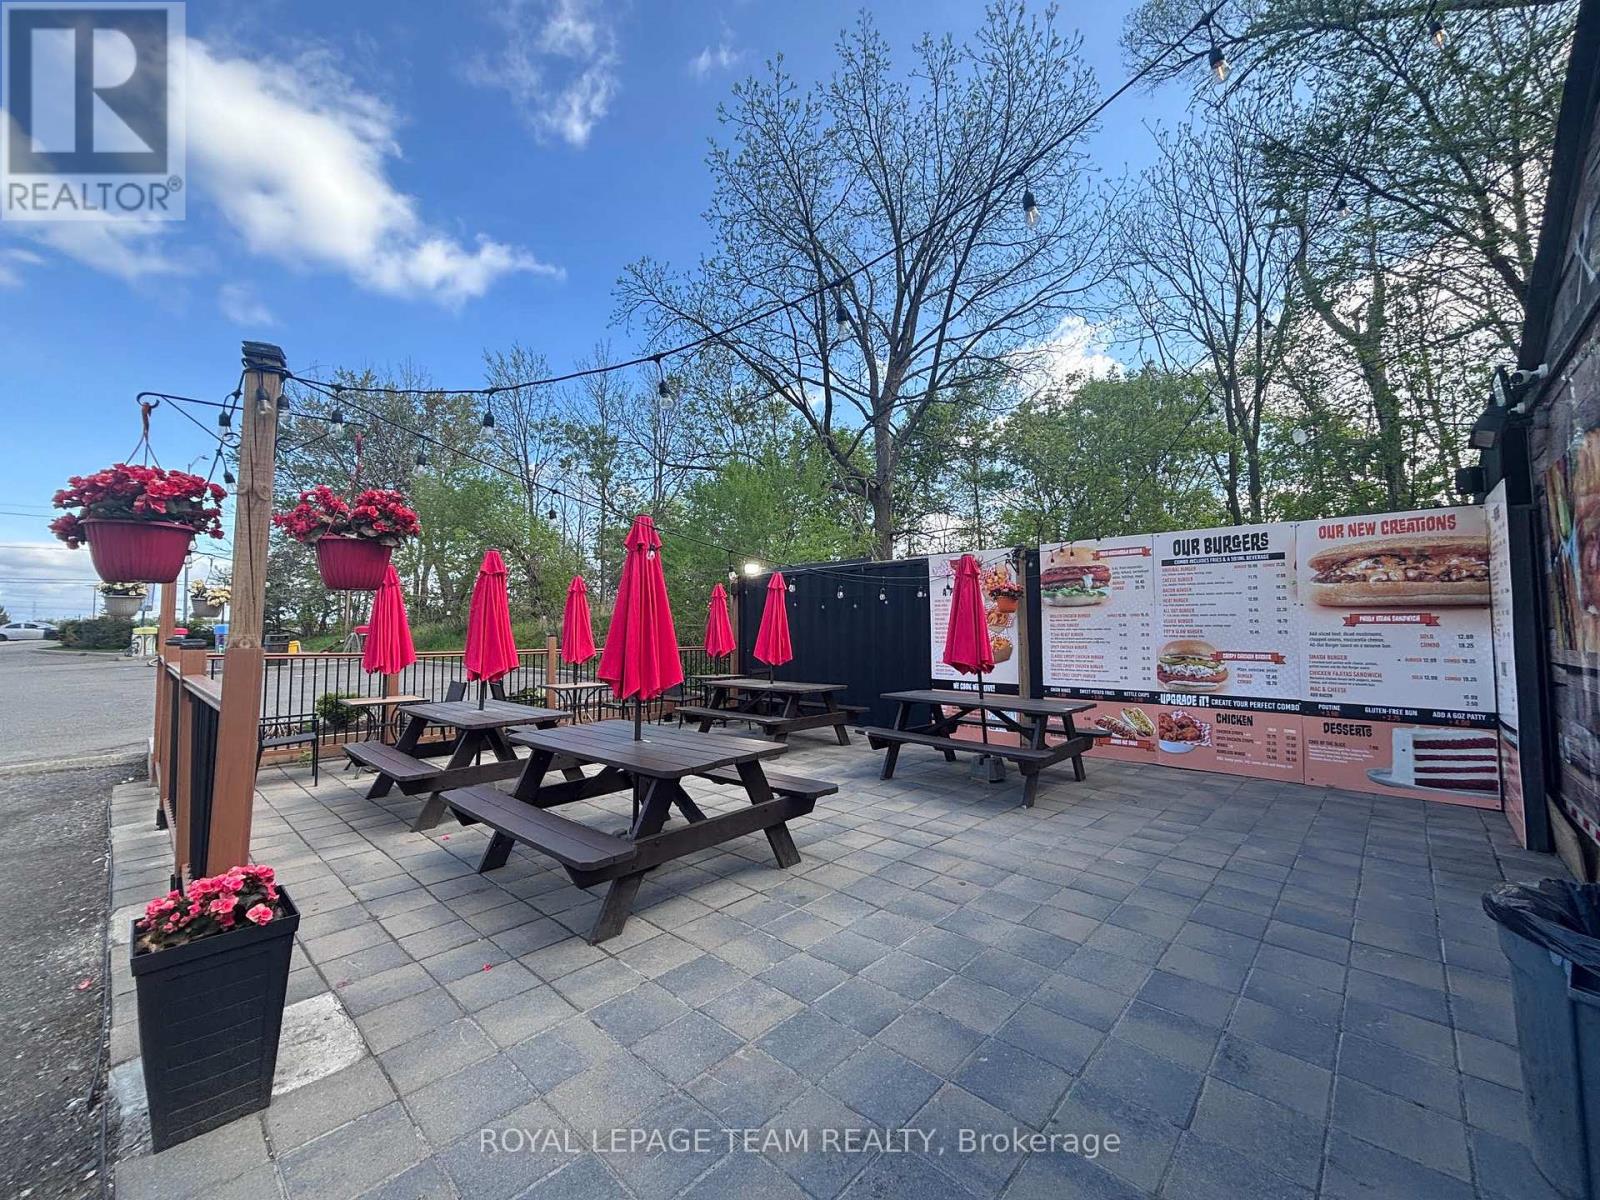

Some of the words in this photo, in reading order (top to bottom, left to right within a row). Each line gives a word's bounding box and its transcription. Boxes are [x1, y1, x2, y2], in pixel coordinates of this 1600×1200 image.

[1319, 524, 1344, 539] OUR
[1348, 521, 1376, 538] NEW
[1173, 538, 1200, 556] OUR
[1204, 532, 1268, 554] BURGERS
[1160, 694, 1197, 706] UPGRADE
[1250, 702, 1276, 710] PERFECT
[1277, 703, 1300, 711] COMBO
[1216, 713, 1253, 726] CHICKEN
[1364, 707, 1404, 716] GLUTEN-FREE
[1324, 722, 1372, 738] DESSERTS
